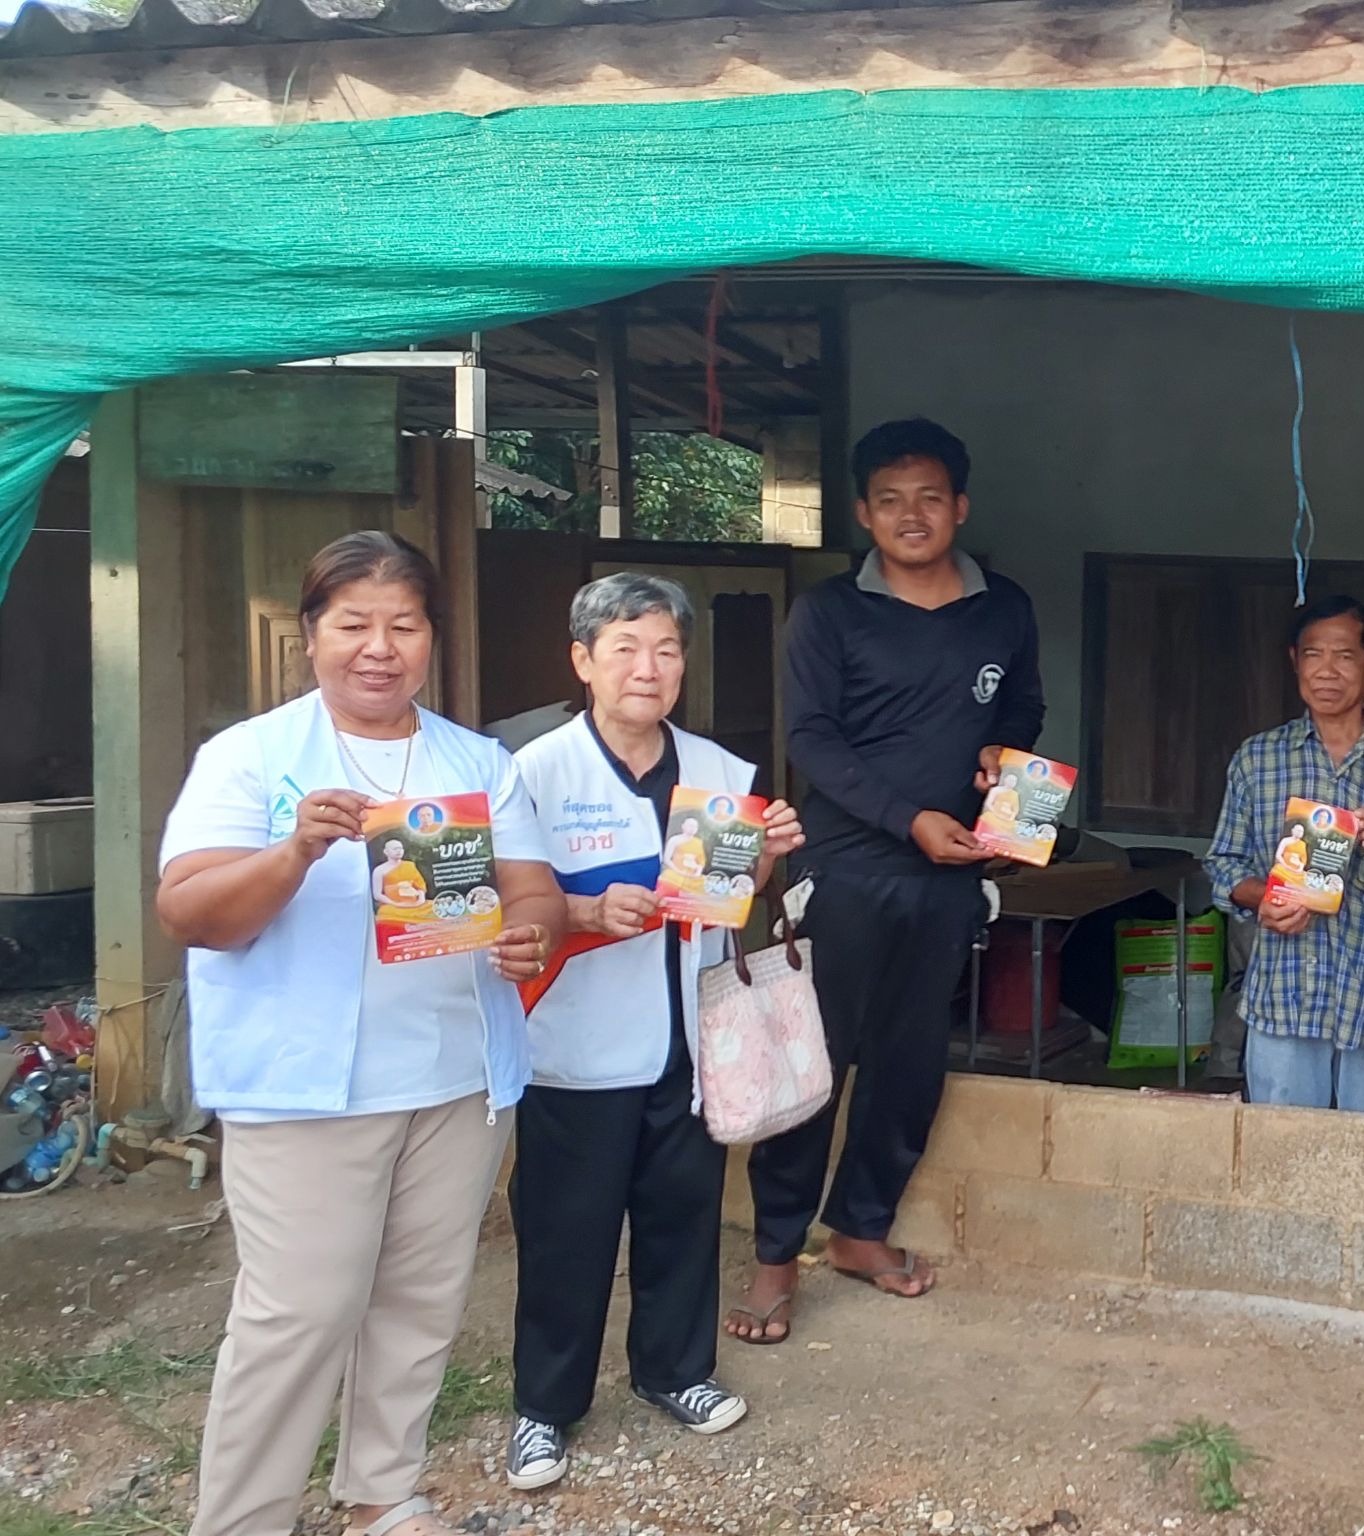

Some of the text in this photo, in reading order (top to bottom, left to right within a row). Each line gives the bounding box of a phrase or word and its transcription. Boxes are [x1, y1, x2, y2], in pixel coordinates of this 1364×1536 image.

[562, 795, 612, 816] ที่สุดของ
[566, 832, 614, 853] บวช
